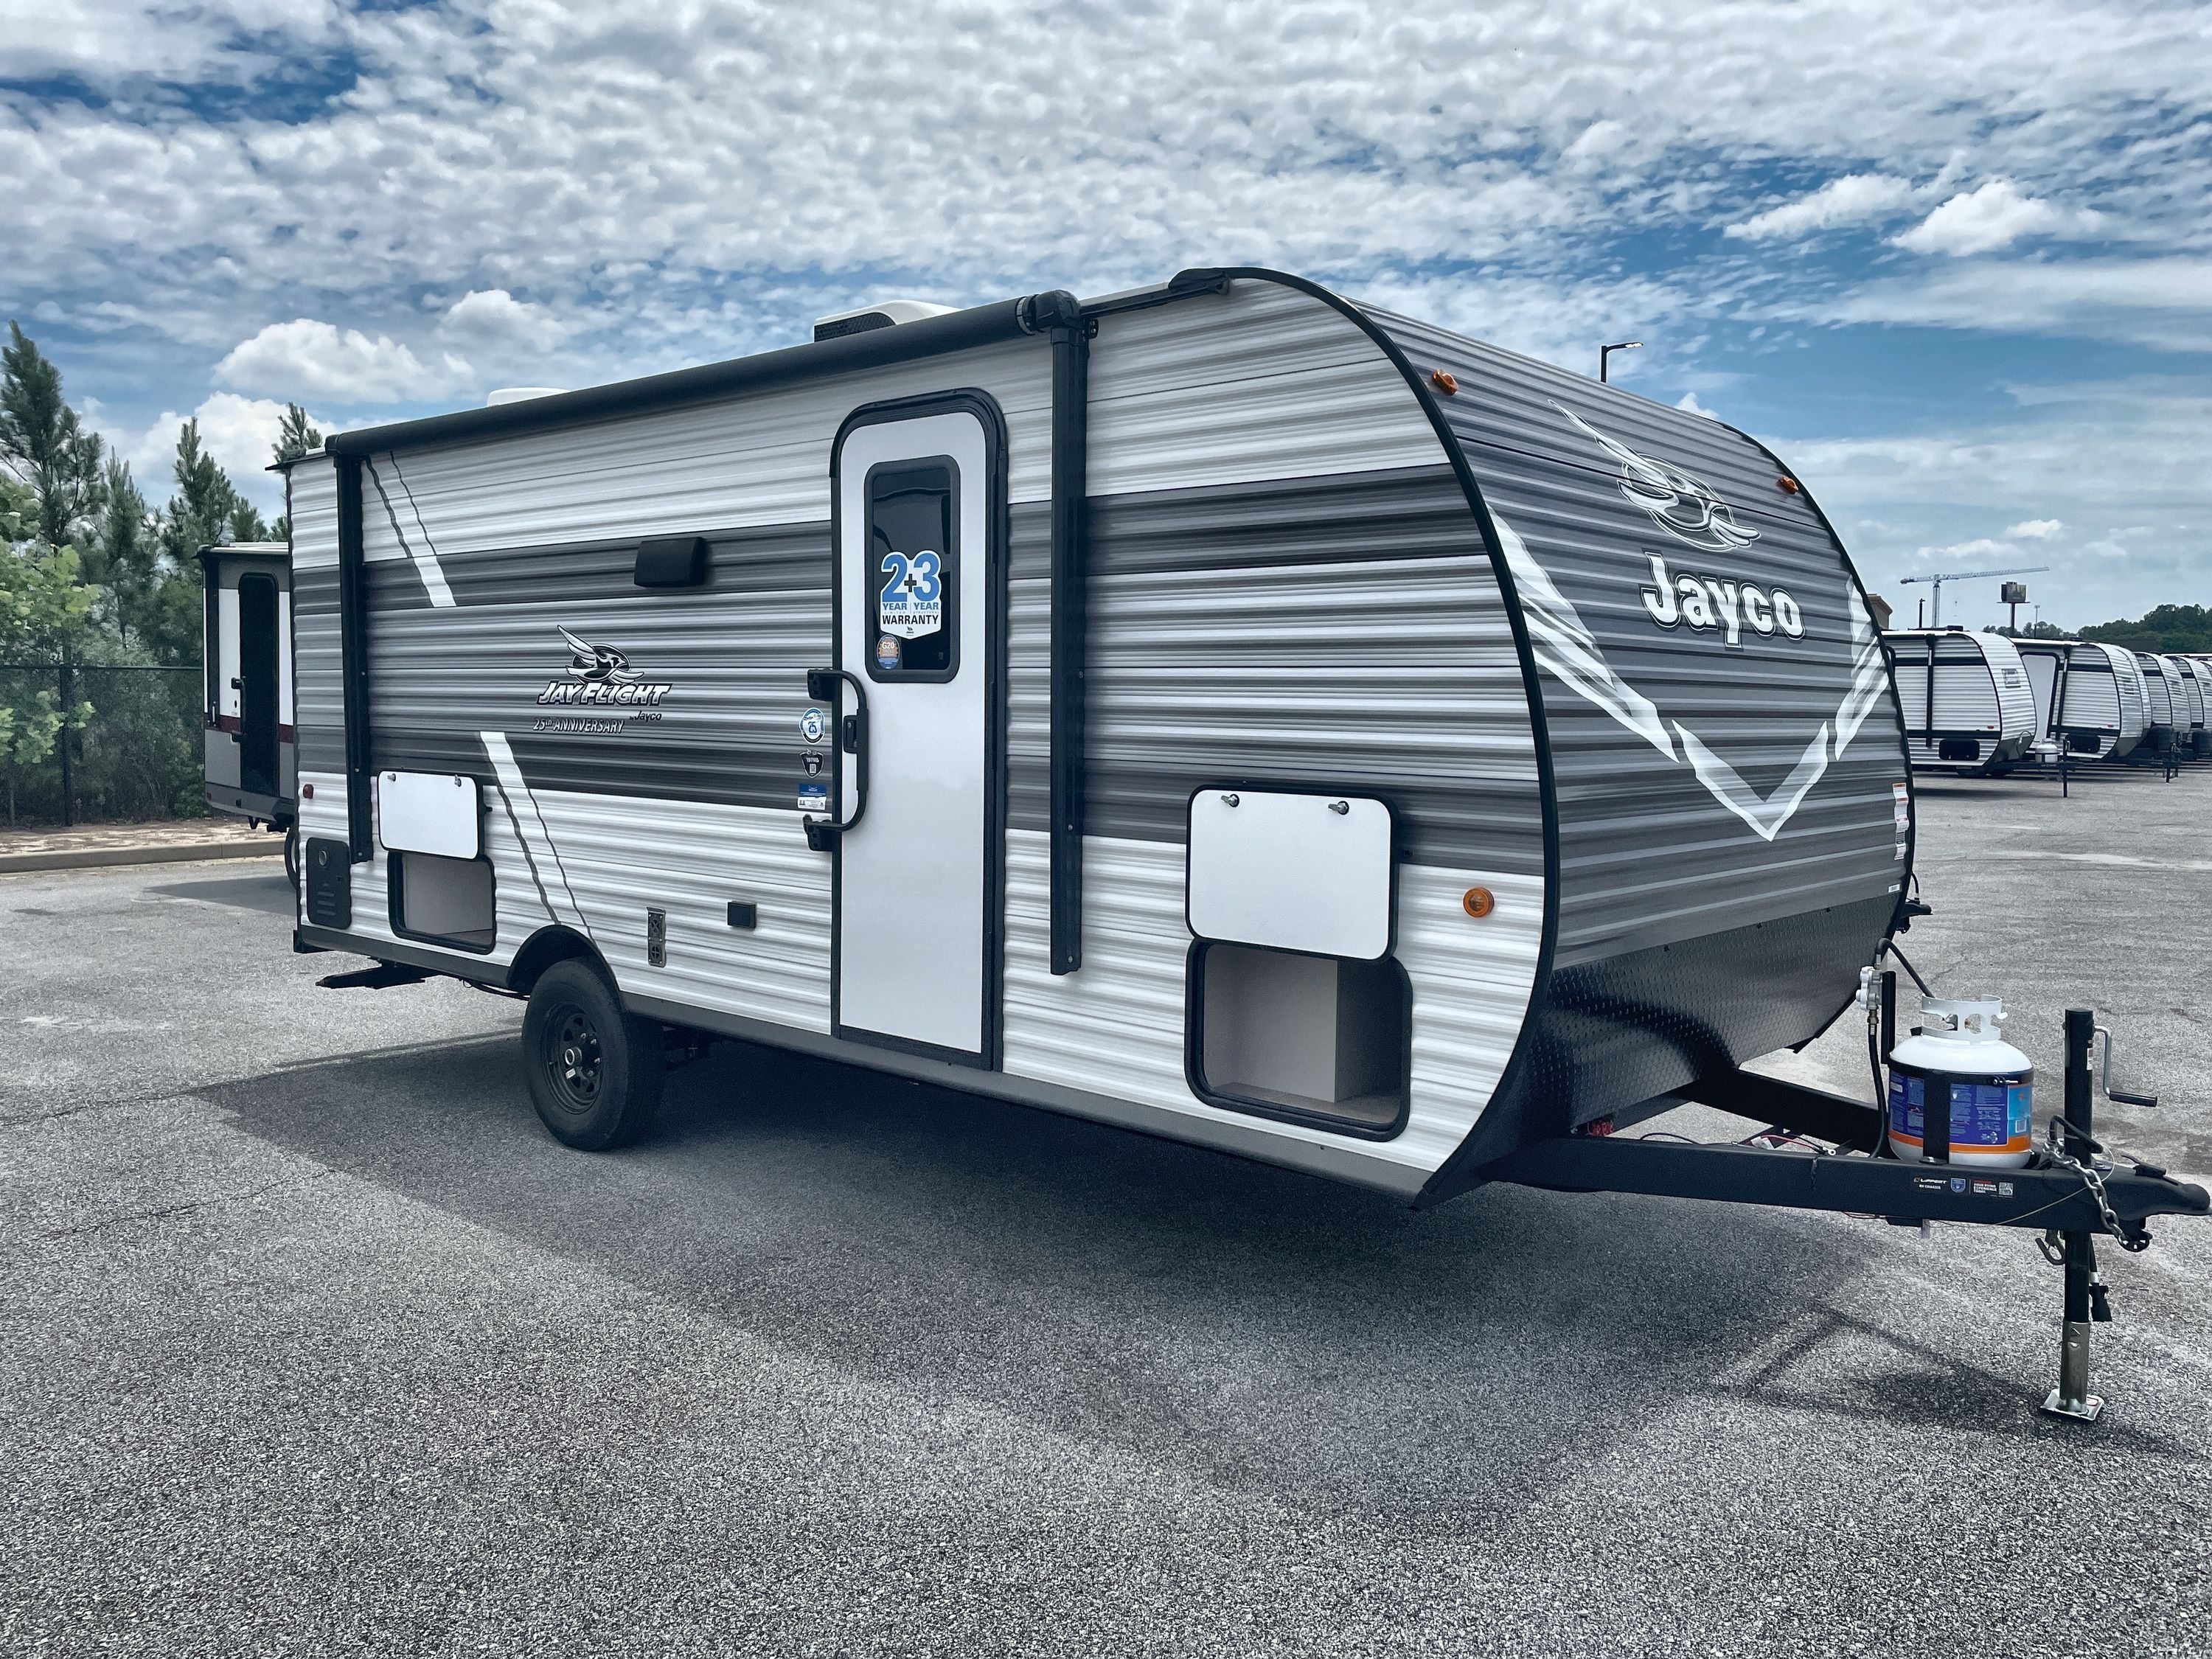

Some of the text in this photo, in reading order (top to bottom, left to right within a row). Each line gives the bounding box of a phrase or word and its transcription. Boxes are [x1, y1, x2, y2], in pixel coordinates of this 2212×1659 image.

[1642, 552, 1804, 648] Jayco
[914, 602, 939, 611] YEAR
[883, 615, 939, 625] WARRANTY
[538, 680, 672, 706] JAY FLIGHT
[634, 711, 662, 722] Jayco
[533, 718, 625, 734] 25th ANNIVERSARY
[808, 721, 817, 733] 25
